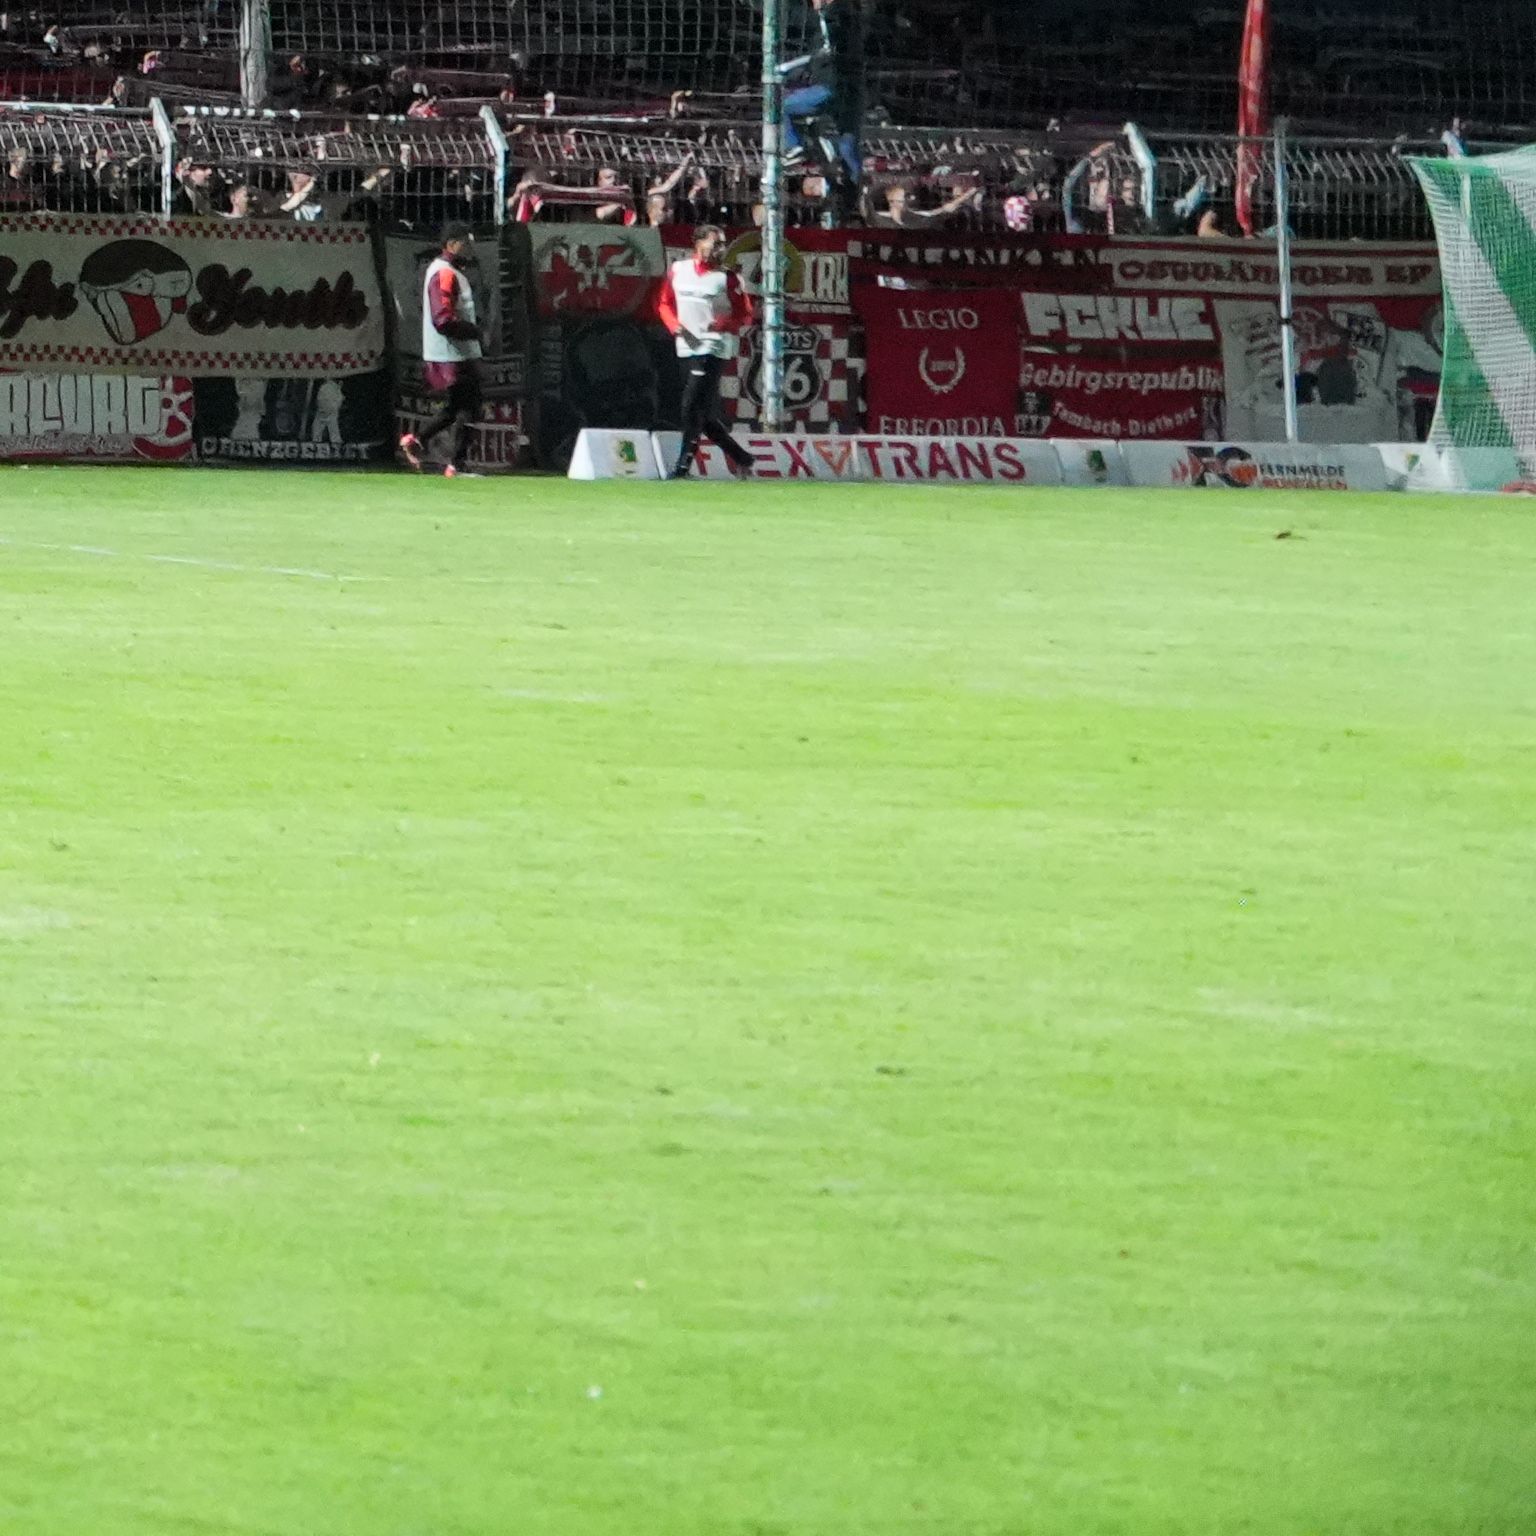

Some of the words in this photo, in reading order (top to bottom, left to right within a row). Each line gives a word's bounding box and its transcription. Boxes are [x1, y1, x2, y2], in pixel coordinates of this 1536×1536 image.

[896, 307, 980, 331] LEGIO
[1019, 362, 1224, 394] Gebirgsrepublik
[878, 414, 1007, 437] ERFORDIA
[200, 436, 373, 459] GRENZGEBIET
